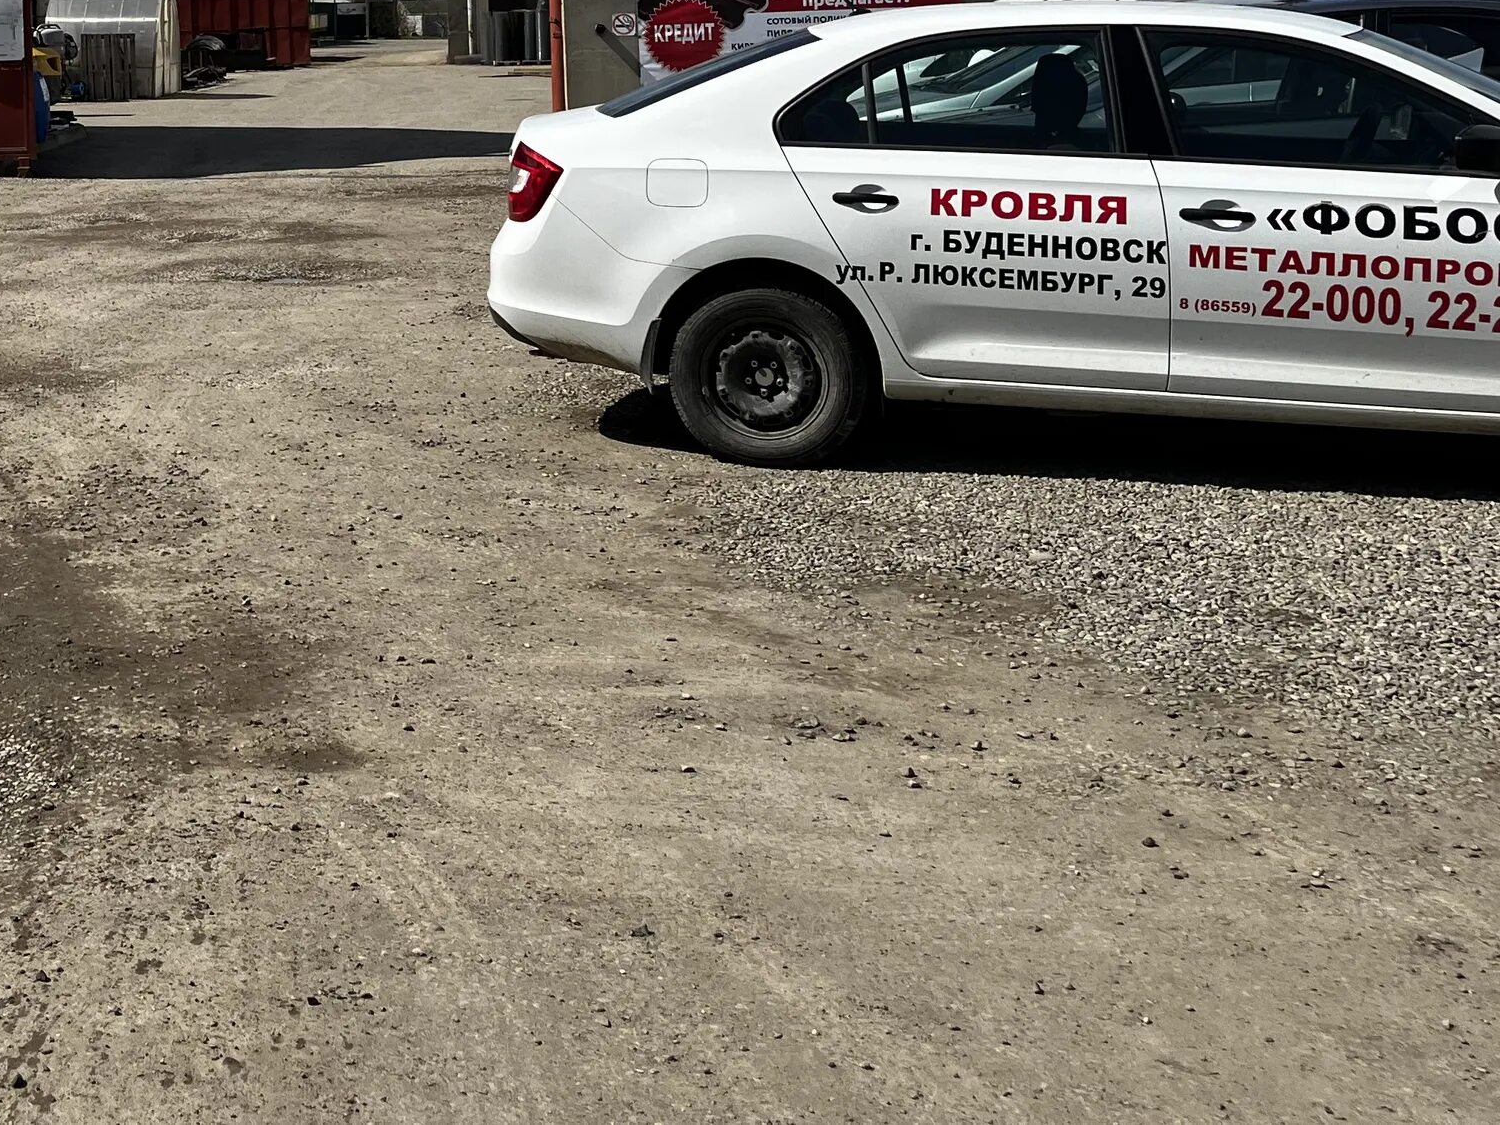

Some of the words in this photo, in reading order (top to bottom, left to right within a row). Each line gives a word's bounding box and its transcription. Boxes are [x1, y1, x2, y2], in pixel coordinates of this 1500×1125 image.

[654, 22, 715, 43] КРЕДИТ
[766, 15, 812, 25] СОТОВЫЙ
[930, 188, 1127, 225] КРОВЛЯ
[1266, 200, 1500, 245] «ФОБО
[910, 233, 932, 251] г.
[943, 229, 1167, 265] БУДЕННОВСК
[1189, 244, 1500, 287] МЕТАЛЛОПРО
[911, 263, 1122, 300] ЛЮКСЕМБУРГ,
[1131, 276, 1166, 298] 29
[1179, 298, 1189, 310] 8
[1195, 299, 1256, 317] (86559)
[1261, 279, 1415, 338] 22-000,
